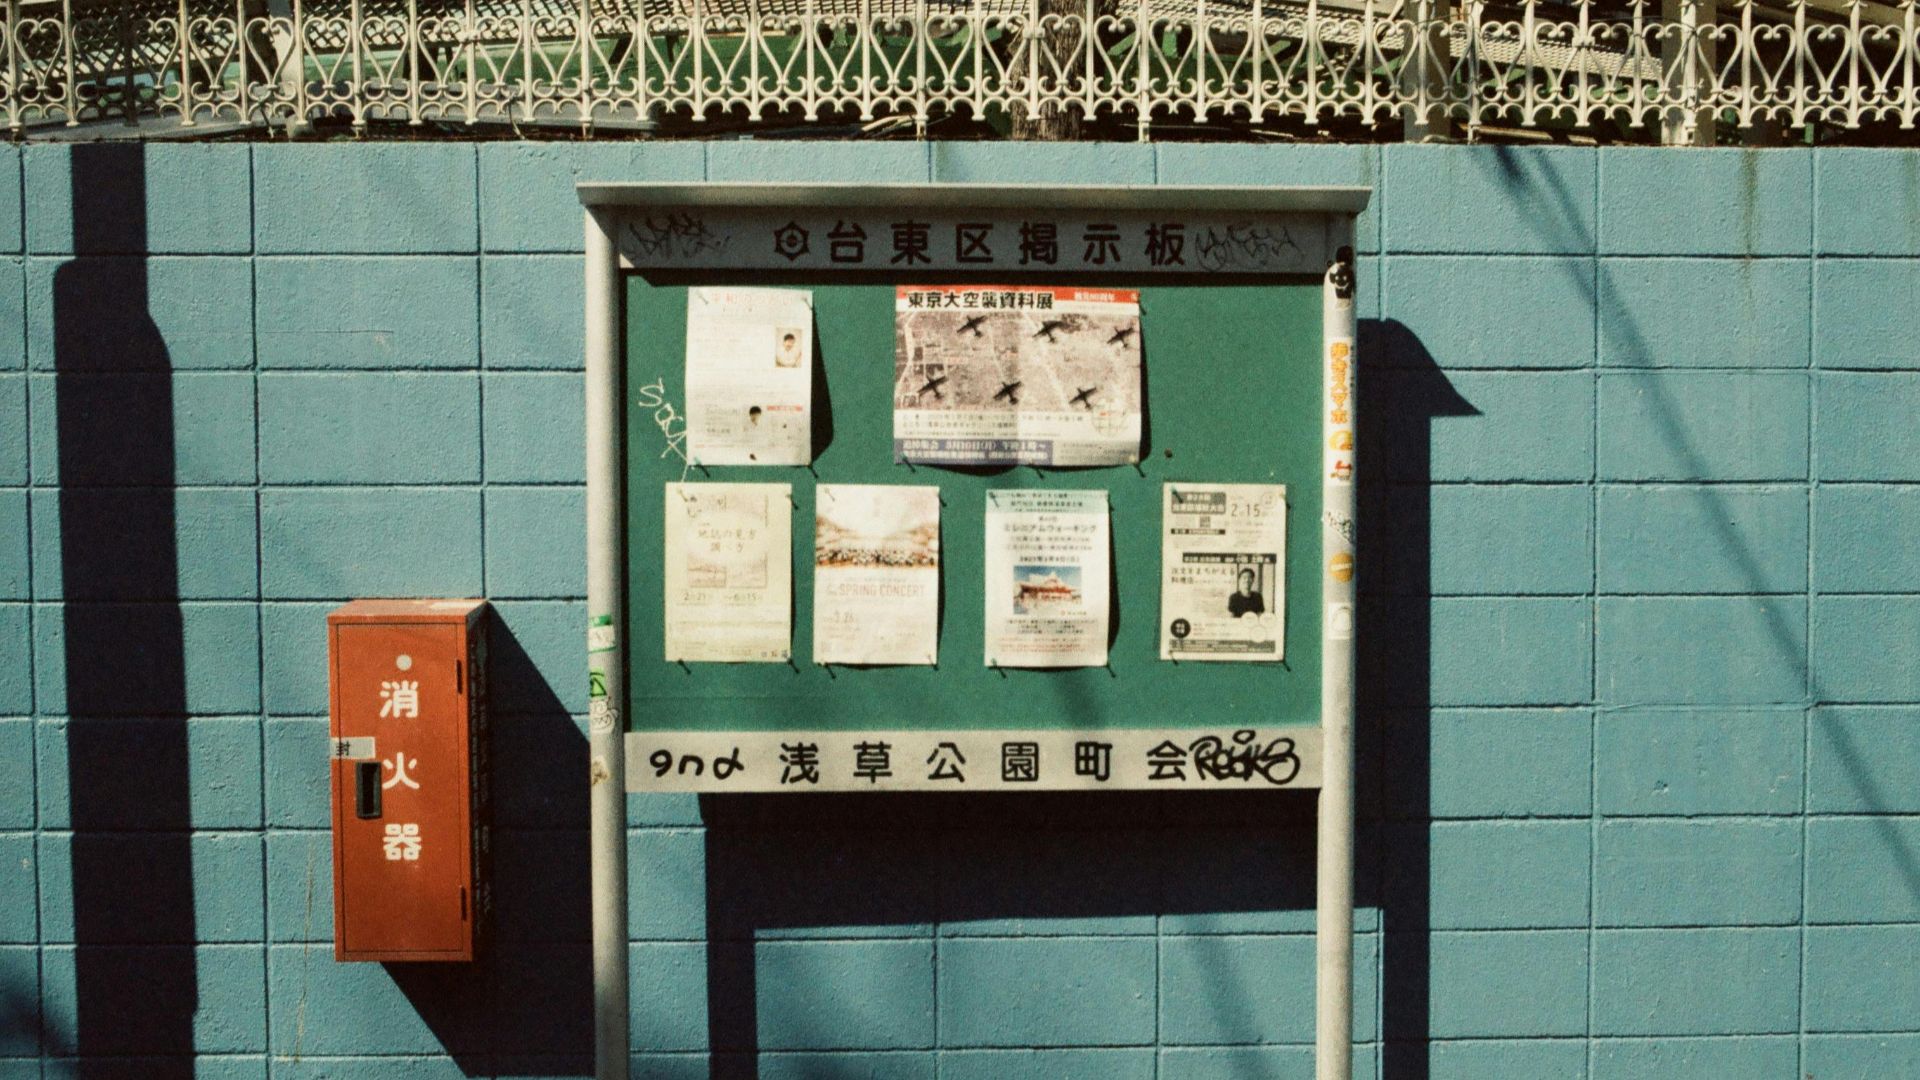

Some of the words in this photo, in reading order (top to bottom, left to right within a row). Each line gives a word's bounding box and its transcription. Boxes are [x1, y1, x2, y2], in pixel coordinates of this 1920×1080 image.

[826, 220, 1186, 265] 台東区掲示板
[907, 291, 1054, 310] 東京大空襲資料展
[379, 679, 422, 862] 消火器
[779, 740, 1187, 784] 浅草公園町会
